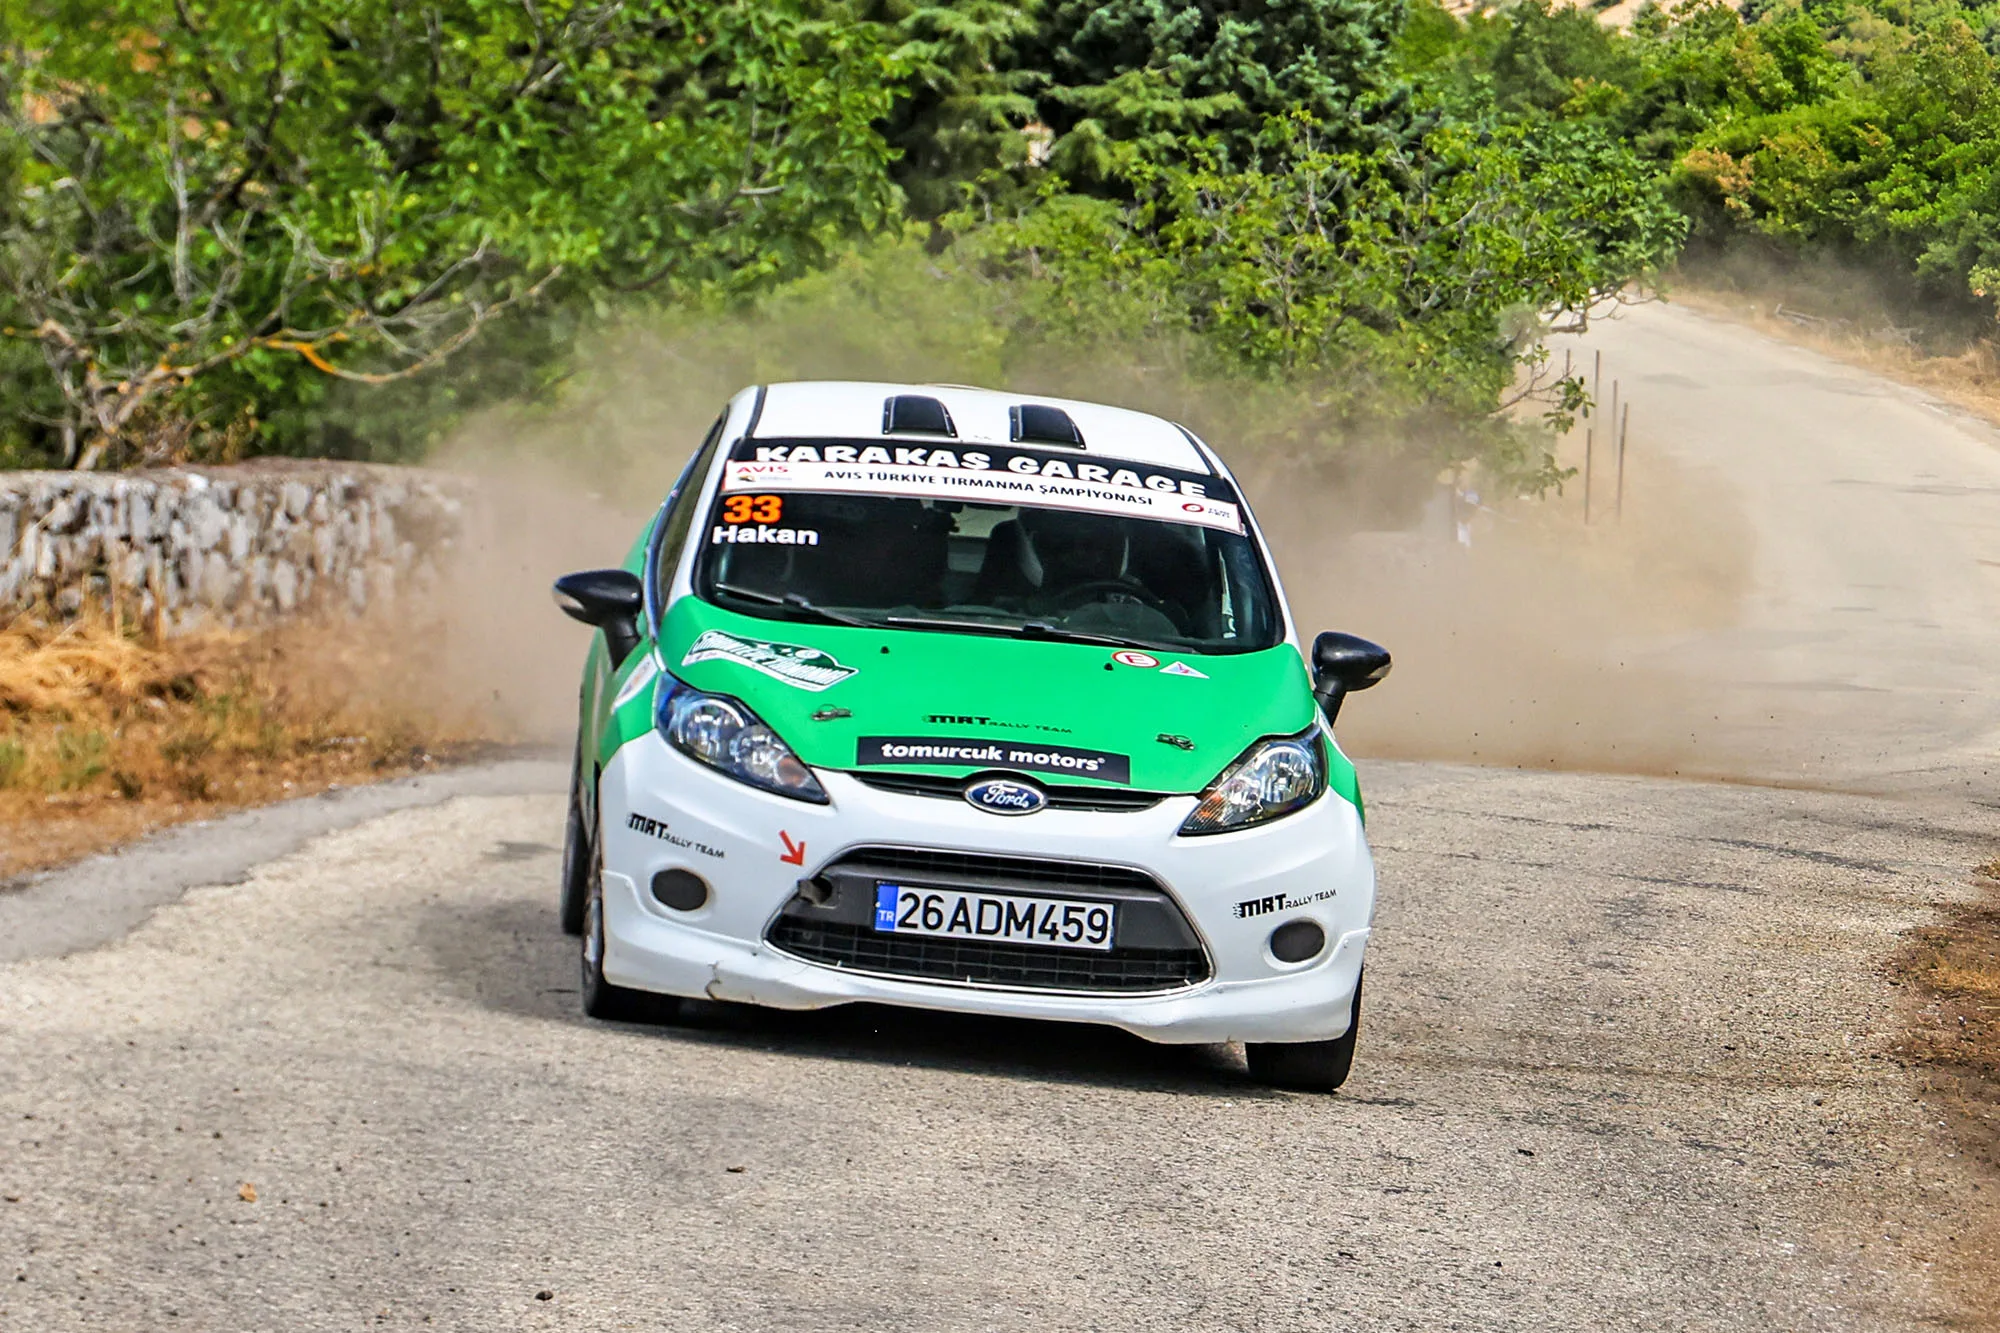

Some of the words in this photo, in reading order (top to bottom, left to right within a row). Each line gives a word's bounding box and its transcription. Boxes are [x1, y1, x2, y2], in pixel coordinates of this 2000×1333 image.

[825, 471, 862, 480] AVIS
[869, 471, 936, 484] TÜRKİYE
[943, 476, 1034, 491] TIRMANMA
[1039, 484, 1153, 506] ŞAMPİYONASI
[1007, 456, 1207, 498] GARAGE
[723, 495, 783, 524] 33
[712, 525, 819, 545] Hakan
[922, 715, 991, 726] MRT
[989, 720, 1030, 729] RALLY
[1035, 725, 1072, 734] TEAM
[881, 743, 1003, 761] tomurcuk
[982, 784, 1029, 808] Ford
[628, 812, 668, 839] MRT
[696, 843, 725, 858] TEAM
[879, 909, 895, 922] TR
[1233, 893, 1286, 918] MRT
[1285, 895, 1313, 909] RALLY
[1314, 889, 1337, 901] TEAM
